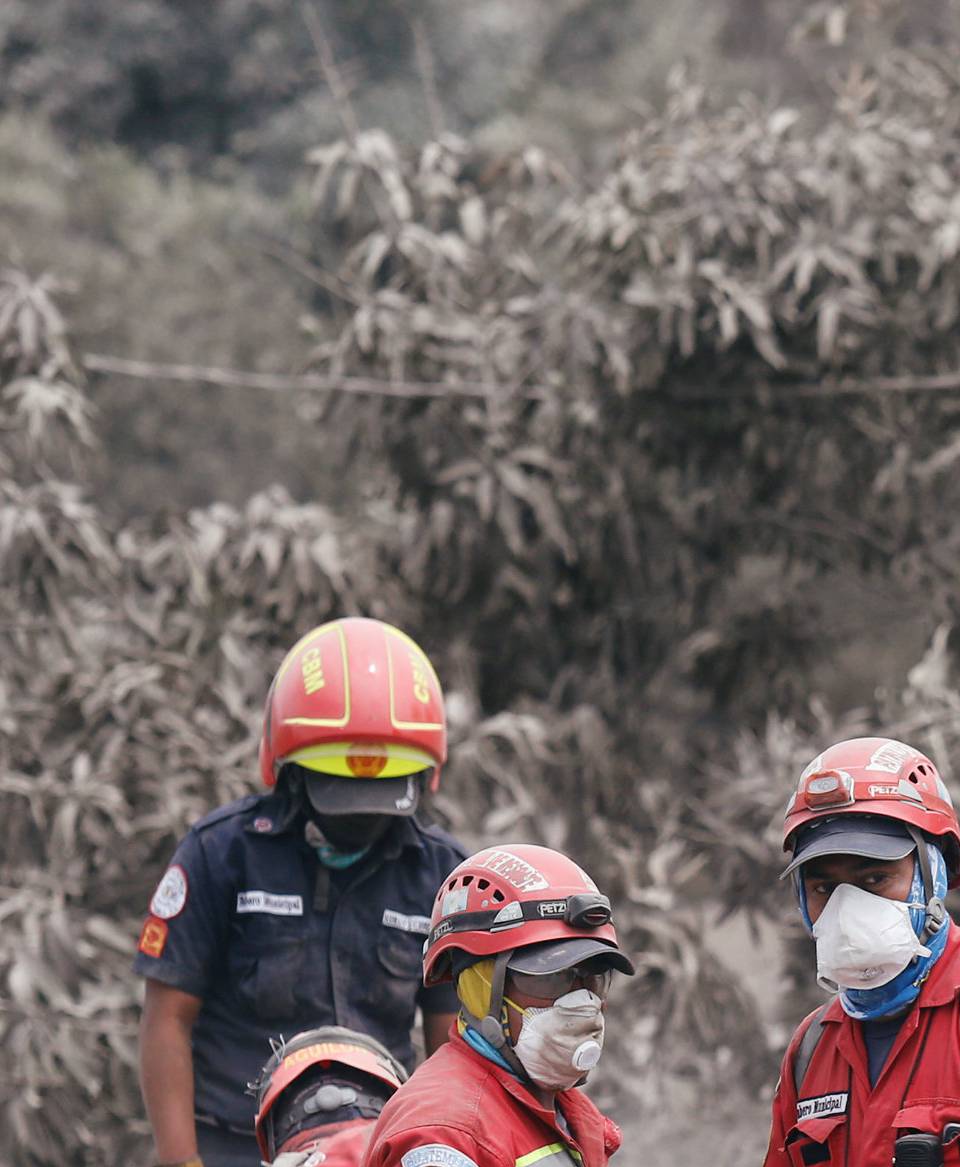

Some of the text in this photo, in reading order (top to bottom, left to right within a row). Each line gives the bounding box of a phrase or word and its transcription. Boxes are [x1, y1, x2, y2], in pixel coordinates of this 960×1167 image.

[302, 648, 325, 695] CBM
[871, 785, 899, 797] PETZ
[798, 1104, 812, 1118] bero
